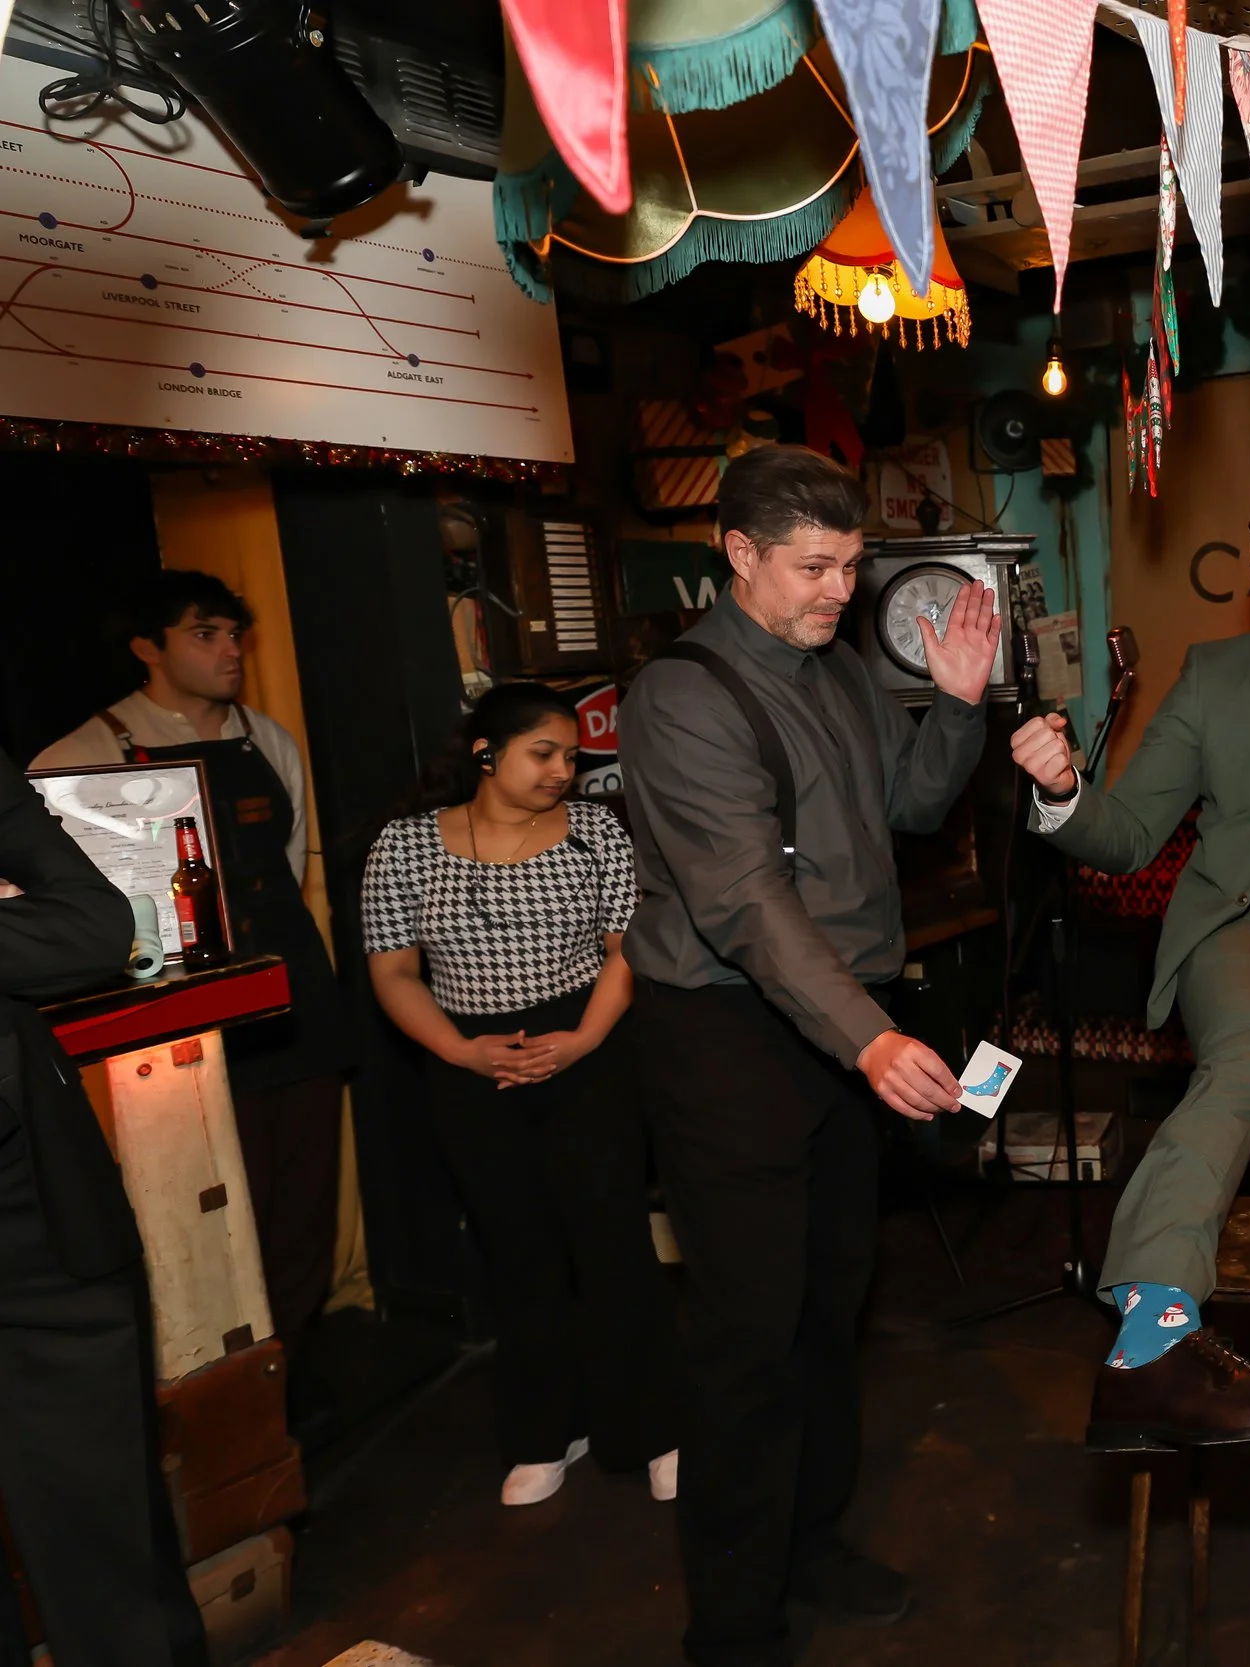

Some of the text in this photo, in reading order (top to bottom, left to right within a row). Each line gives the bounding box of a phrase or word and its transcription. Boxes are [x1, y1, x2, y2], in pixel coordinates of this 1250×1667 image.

[0, 140, 23, 153] EET
[19, 233, 84, 252] MOORGATE
[102, 291, 201, 313] LIVERPOOL STREET
[387, 371, 444, 384] ALDGATE EAST
[158, 382, 242, 400] LONDON BRIDGE
[906, 473, 928, 495] NO
[886, 497, 949, 522] SMOG
